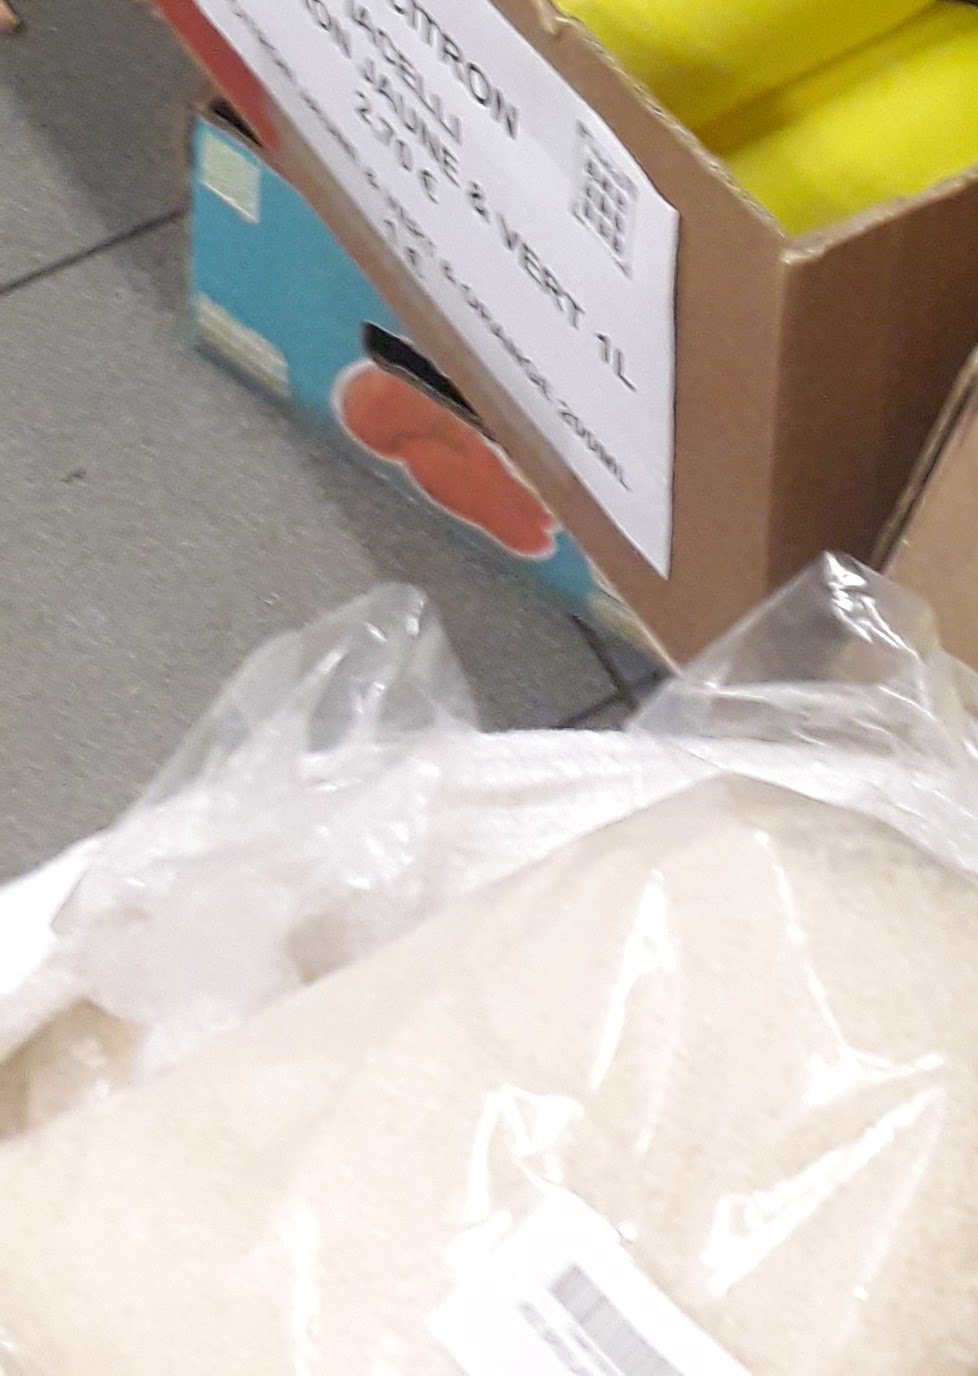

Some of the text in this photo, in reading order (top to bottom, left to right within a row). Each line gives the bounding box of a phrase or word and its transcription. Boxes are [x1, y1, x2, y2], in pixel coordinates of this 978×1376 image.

[361, 59, 460, 187] JAUNE
[467, 178, 491, 223] &
[497, 210, 587, 328] VERT
[595, 330, 638, 393] 1L
[418, 167, 441, 205] €
